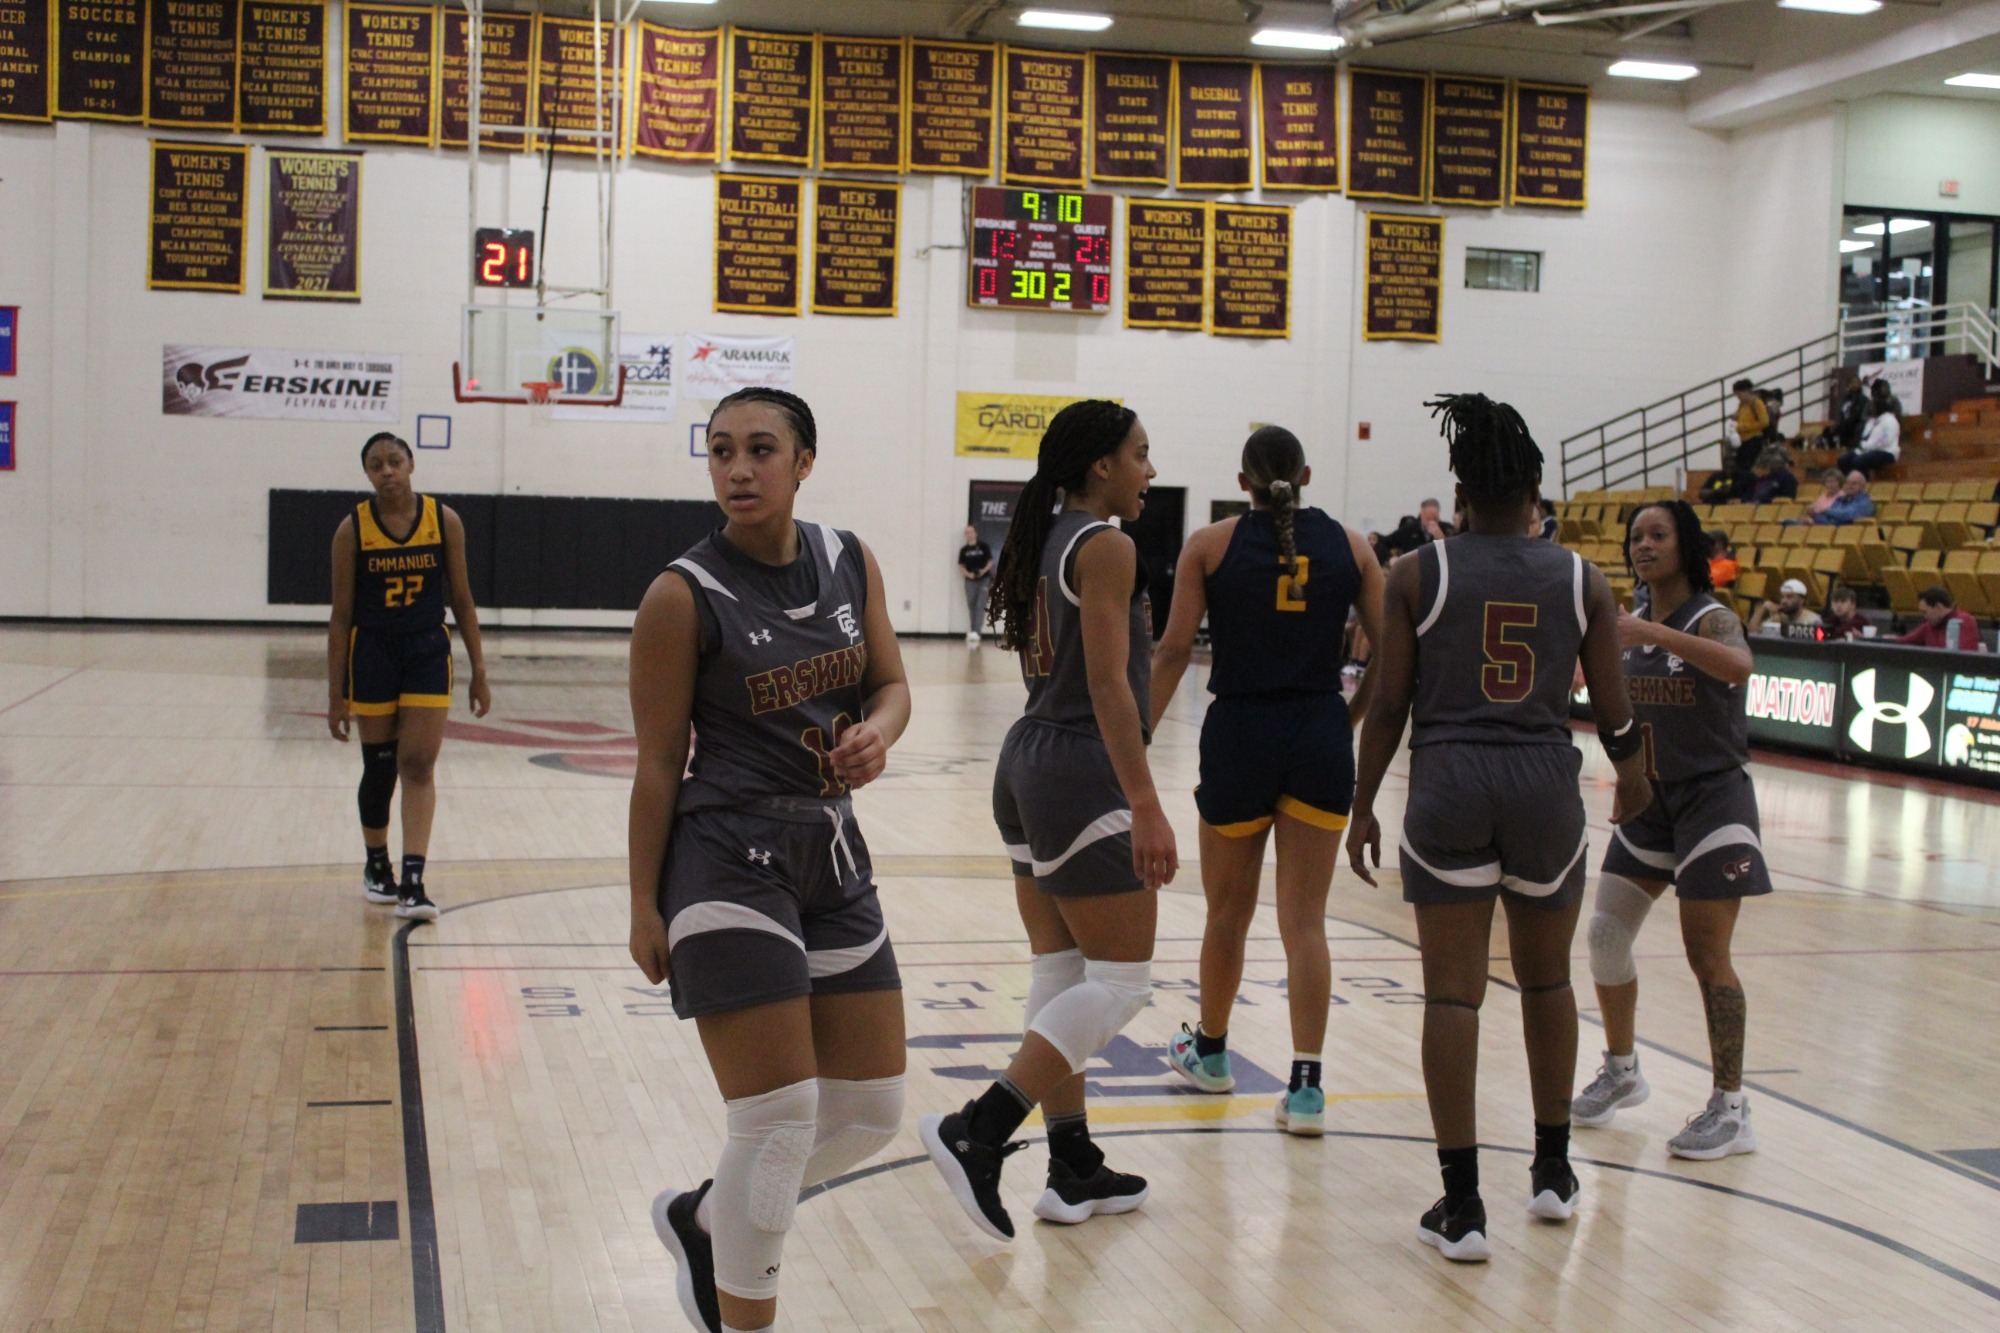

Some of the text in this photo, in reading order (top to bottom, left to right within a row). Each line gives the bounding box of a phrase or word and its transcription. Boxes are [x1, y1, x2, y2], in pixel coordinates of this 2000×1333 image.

[68, 6, 136, 24] SOCCER
[253, 8, 311, 24] WOMEN'S
[361, 14, 420, 30] WOMEN'S
[170, 20, 219, 35] TENNIS
[256, 26, 306, 41] TENNIS
[87, 32, 118, 42] CVAC
[155, 36, 233, 49] CVAC CHAMPIONS
[367, 32, 415, 48] TENNIS
[268, 44, 321, 55] CHAMPIONS
[655, 38, 705, 56] WOMEN'S
[747, 40, 799, 56] WOMEN'S
[836, 45, 888, 59] WOMEN'S
[73, 50, 131, 64] CHAMPION
[152, 49, 236, 62] CVAC TOURNAMENT
[376, 50, 429, 62] CHAMPIONS
[165, 64, 222, 75] CHAMPIONS
[265, 57, 323, 69] TOURNAMENT
[373, 64, 431, 75] TOURNAMENT
[655, 58, 702, 75] TENNIS
[751, 55, 796, 71] TENNIS
[839, 61, 884, 75] TENNIS
[1020, 61, 1072, 78] WOMEN'S
[252, 69, 310, 81] CHAMPIONS
[931, 66, 975, 82] TENNIS
[1107, 73, 1158, 88] BASEBALL
[155, 77, 231, 90] NCAA REGIONAL
[242, 82, 320, 95] NCAA REGIONAL
[362, 77, 418, 89] CHAMPIONS
[1025, 77, 1068, 93] TENNIS
[161, 91, 225, 102] TOURNAMENT
[352, 91, 426, 103] NCAA REGIONAL
[1191, 87, 1241, 102] BASEBALL
[1444, 84, 1495, 100] SOFTBALL
[248, 96, 314, 108] TOURNAMENT
[643, 102, 667, 115] NCAA
[357, 104, 421, 117] TOURNAMENT
[1281, 103, 1318, 116] TENNIS
[1370, 107, 1403, 122] TENNIS
[1106, 115, 1158, 125] CHAMPIONS
[1537, 115, 1566, 129] GOLF
[1191, 128, 1241, 139] CHAMPIONS
[1287, 123, 1314, 133] STATE
[1275, 140, 1324, 150] CHAMPIONS
[170, 154, 231, 170] WOMEN'S
[1358, 152, 1414, 166] TOURNAMENT
[280, 158, 349, 176] WOMEN'S
[175, 172, 224, 187] TENNIS
[291, 176, 338, 191] TENNIS
[186, 190, 238, 201] CAROLINAS
[741, 184, 778, 199] MEN'S
[839, 191, 876, 206] MEN'S
[191, 203, 227, 214] SEASON
[720, 198, 798, 217] VOLLEYBALL
[818, 205, 895, 221] VOLLEYBALL
[748, 217, 794, 229] CAROLINAS
[1144, 209, 1192, 224] WOMEN'S
[1228, 214, 1278, 230] WOMEN'S
[295, 220, 333, 231] NCAA
[975, 218, 1016, 230] ERSKINE
[1028, 223, 1057, 232] PERIOD
[1074, 224, 1106, 235] GUEST
[1382, 223, 1430, 239] WOMEN'S
[171, 228, 224, 240] CHAMPIONS
[282, 232, 345, 242] REGIONALS
[1131, 225, 1203, 240] VOLLEYBALL
[1216, 230, 1288, 245] VOLLEYBALL
[160, 240, 233, 253] NCAA NATIONAL
[1371, 238, 1439, 252] VOLLEYBALL
[166, 254, 228, 266] TOURNAMENT
[733, 255, 782, 266] CHAMPIONS
[1029, 251, 1056, 259] BONUS
[483, 244, 527, 282] 21
[973, 258, 998, 267] FOULS
[1015, 261, 1044, 270] PLAYER
[1053, 263, 1072, 271] FOUL
[1085, 265, 1110, 273] FOULS
[724, 268, 748, 277] NCAA
[295, 277, 330, 291] 2021
[980, 269, 996, 295] 0
[1011, 270, 1046, 299] 30
[1053, 273, 1070, 300] 2
[1092, 274, 1109, 301] 0
[720, 350, 790, 362] ARAMARK
[625, 365, 670, 381] CCAA
[243, 375, 391, 397] ERSKINE
[285, 397, 387, 410] FLYING FLEET
[1005, 404, 1059, 413] CONFER
[978, 412, 1049, 429] CAROL
[981, 502, 1007, 515] THE
[368, 554, 437, 572] EMMANUEL
[385, 575, 424, 607] 22
[1276, 556, 1309, 612] 2
[1481, 601, 1538, 702] 5
[746, 642, 868, 715] ERSKIN
[1628, 677, 1696, 706] SKINE
[1745, 674, 1836, 727] NATION
